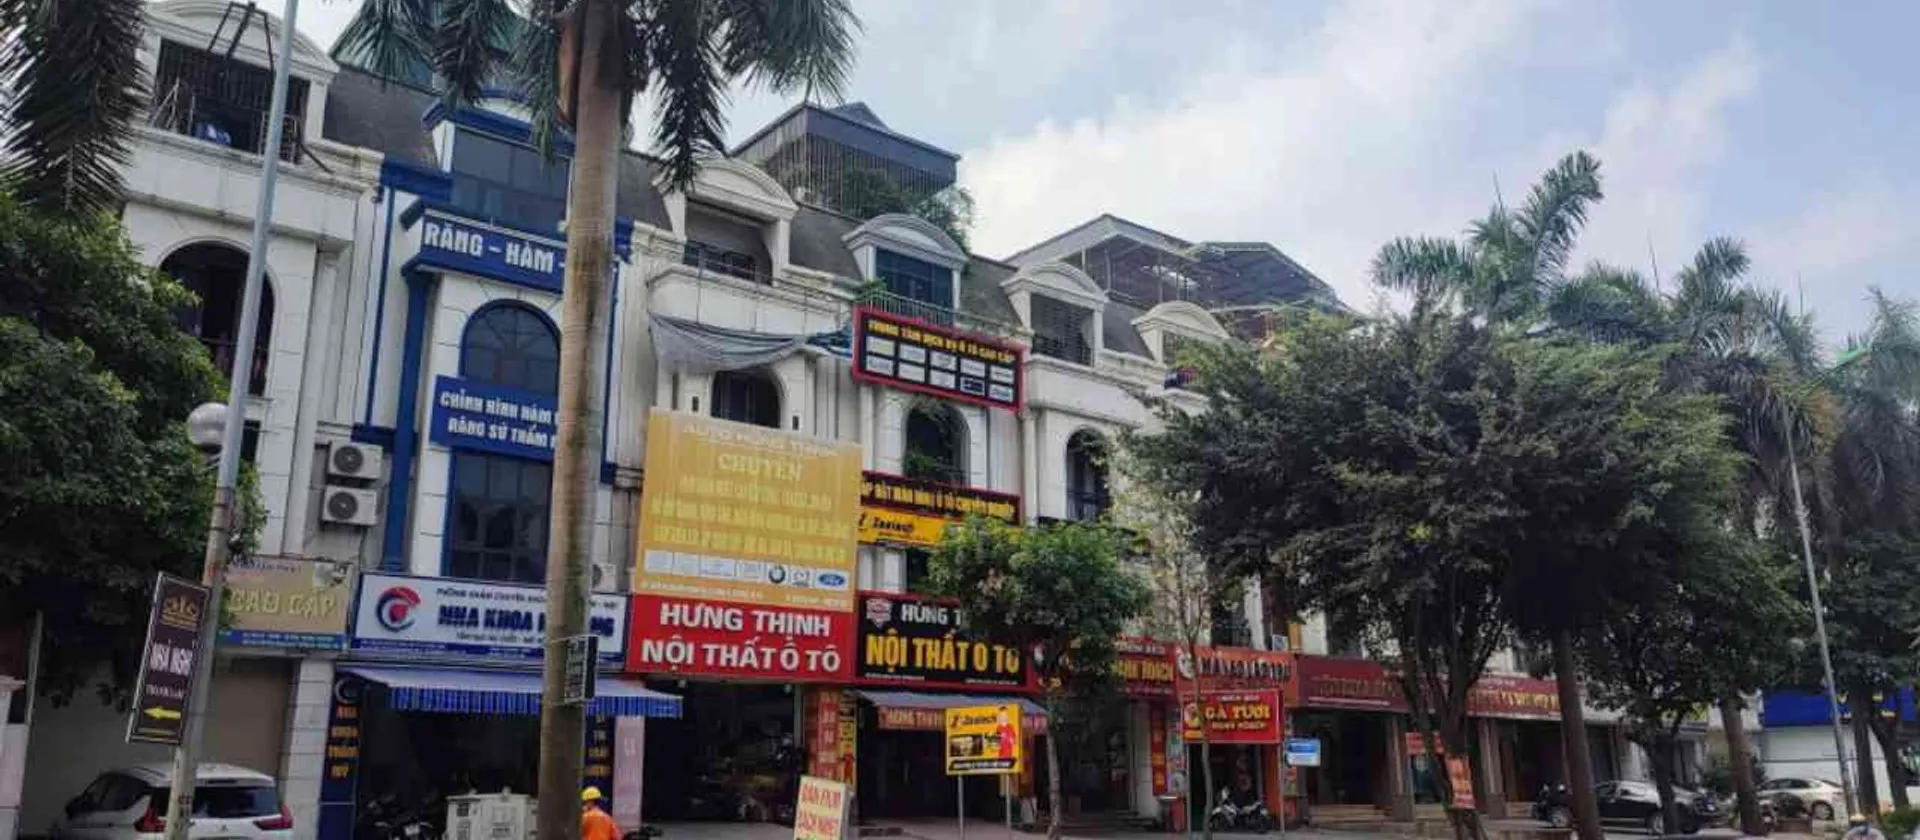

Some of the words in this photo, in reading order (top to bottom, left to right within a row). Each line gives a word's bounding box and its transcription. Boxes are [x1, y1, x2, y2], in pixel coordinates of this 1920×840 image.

[424, 221, 484, 258] RĂNG
[505, 240, 554, 274] HÀM
[485, 396, 518, 418] HÌNH
[521, 403, 551, 423] HÀM
[448, 415, 485, 438] RĂNG
[437, 604, 479, 628] NHA
[483, 608, 534, 632] KHOA
[659, 602, 744, 632] HƯNG
[752, 609, 831, 640] THỊNH
[641, 633, 694, 671] NỘI
[702, 635, 776, 669] THẤT
[780, 642, 800, 671] Ô
[805, 644, 841, 673] TÔ
[865, 628, 907, 673] NỘI
[912, 628, 970, 672] THẤT
[1205, 702, 1227, 719] GÀ
